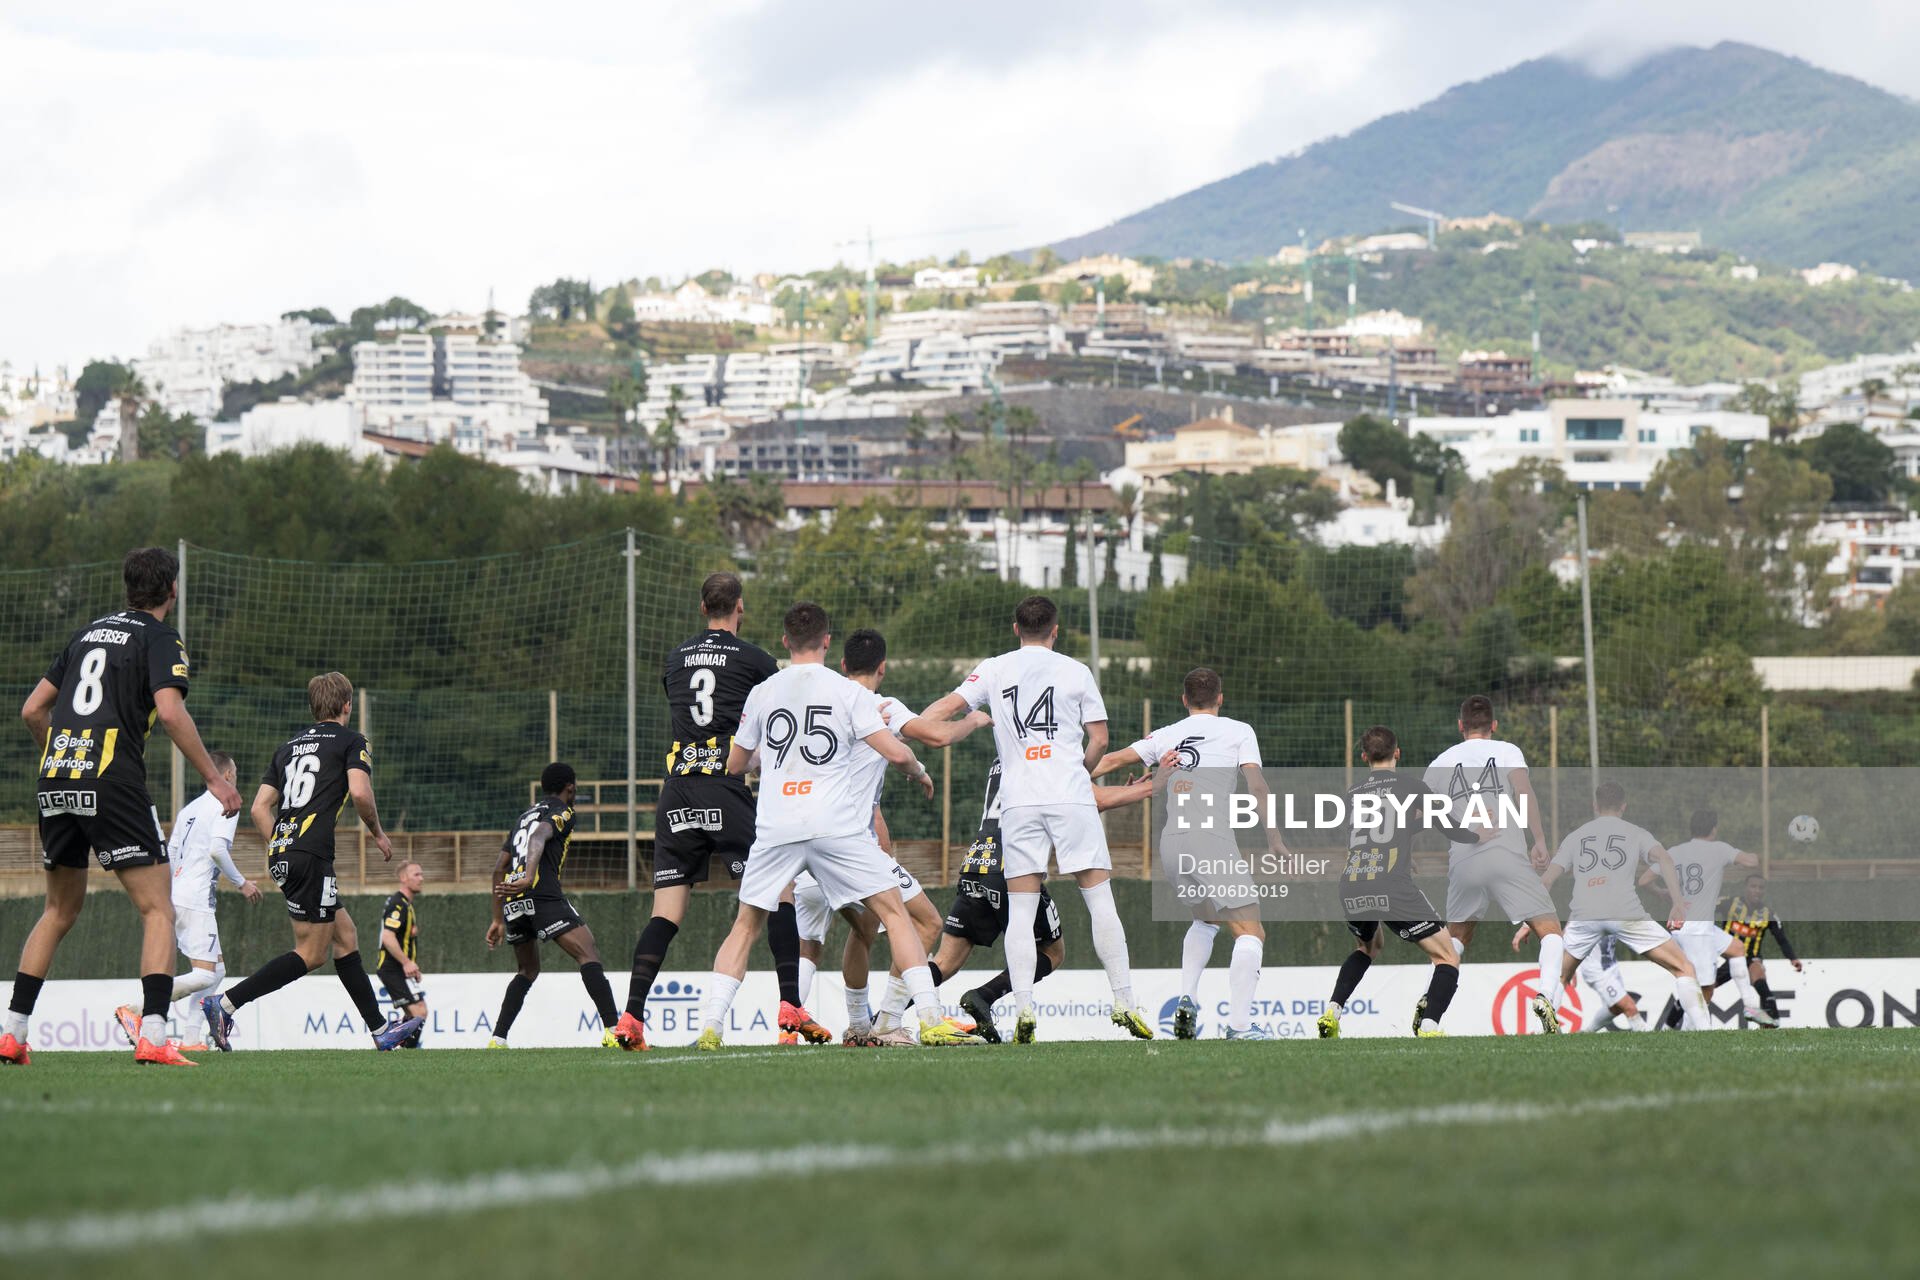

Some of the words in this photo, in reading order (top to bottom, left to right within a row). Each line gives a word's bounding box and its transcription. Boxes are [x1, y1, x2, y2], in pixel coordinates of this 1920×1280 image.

[80, 628, 131, 646] ANDERSEN
[684, 653, 727, 668] HAMMAR
[71, 647, 107, 716] 8
[689, 667, 716, 727] 3
[1002, 685, 1058, 740] 14
[69, 736, 94, 748] Brion
[766, 705, 838, 770] 95
[291, 742, 320, 757] DAHBO
[698, 747, 722, 758] Brion
[1025, 744, 1052, 761] GG
[281, 754, 321, 810] 16
[782, 780, 813, 796] GG
[1173, 780, 1194, 794] GG
[1448, 757, 1504, 803] 44
[38, 790, 97, 811] DEMO
[667, 807, 723, 827] DEMO
[112, 845, 141, 856] NORDISK
[1578, 834, 1627, 873] 55
[1587, 876, 1608, 888] GG
[1675, 863, 1704, 896] 18
[207, 933, 217, 953] 7
[1606, 985, 1618, 998] 8
[1031, 1000, 1114, 1017] rovincia
[1216, 1000, 1286, 1017] CSTA
[1825, 988, 1920, 1028] ON
[304, 1010, 493, 1033] MALLA
[578, 1008, 769, 1032] MRBELA
[1216, 1021, 1306, 1038] MAGA
